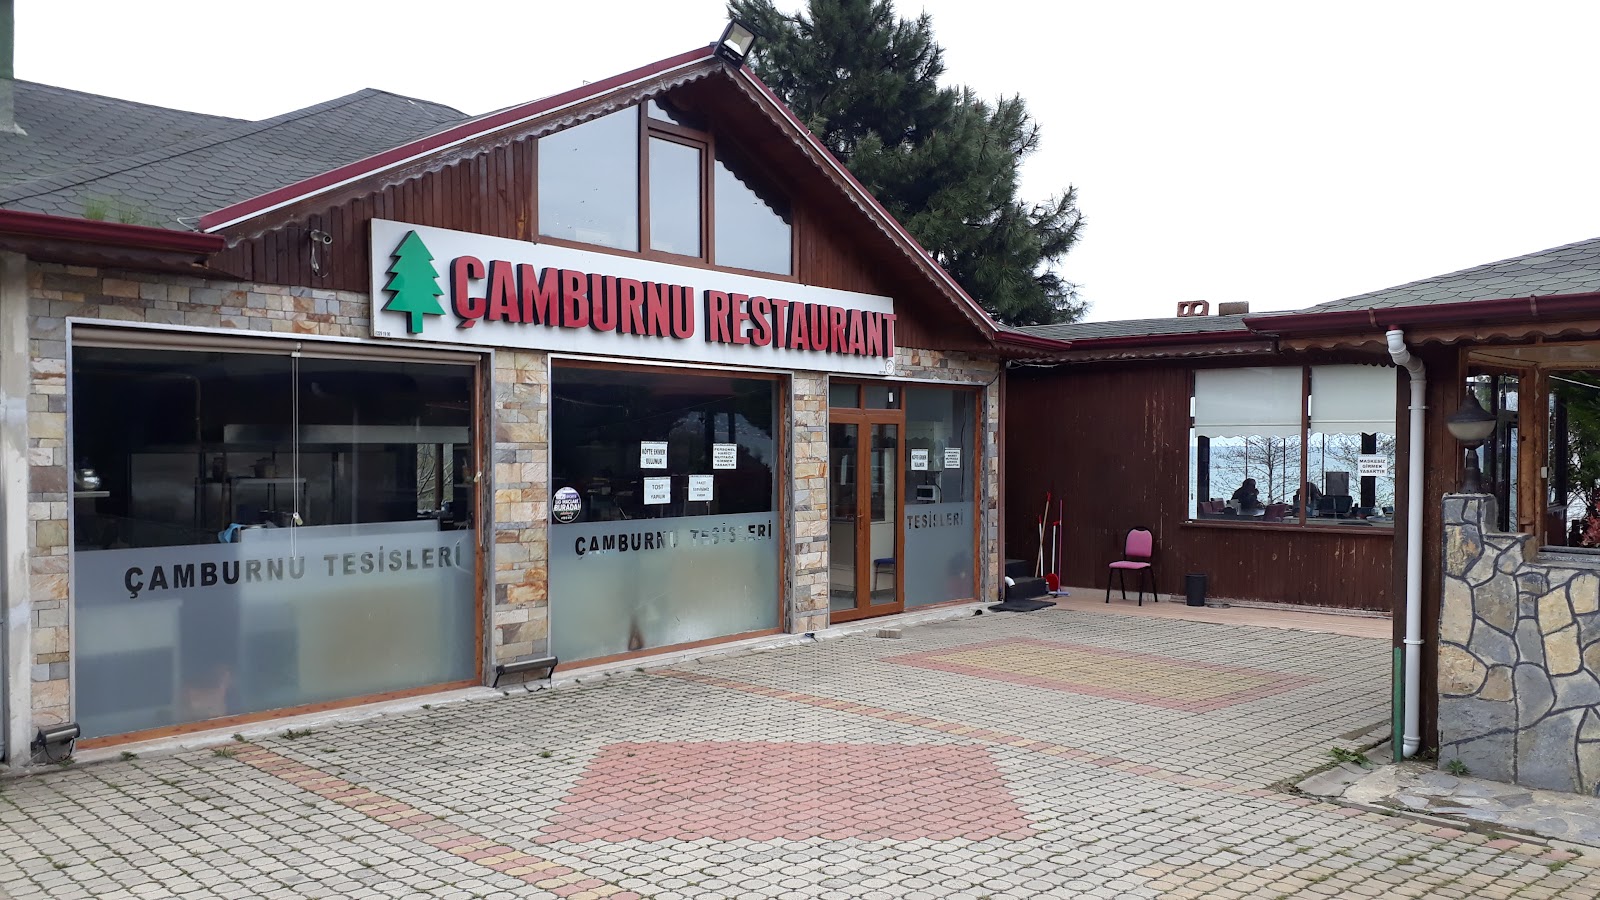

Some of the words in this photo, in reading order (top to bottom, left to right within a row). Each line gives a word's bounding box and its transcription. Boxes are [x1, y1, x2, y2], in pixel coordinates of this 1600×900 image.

[450, 255, 695, 339] ÇAMBURNU
[704, 289, 897, 358] RESTAURANT
[124, 556, 305, 599] ÇAMBURNU
[323, 540, 462, 578] TESİSLERİ
